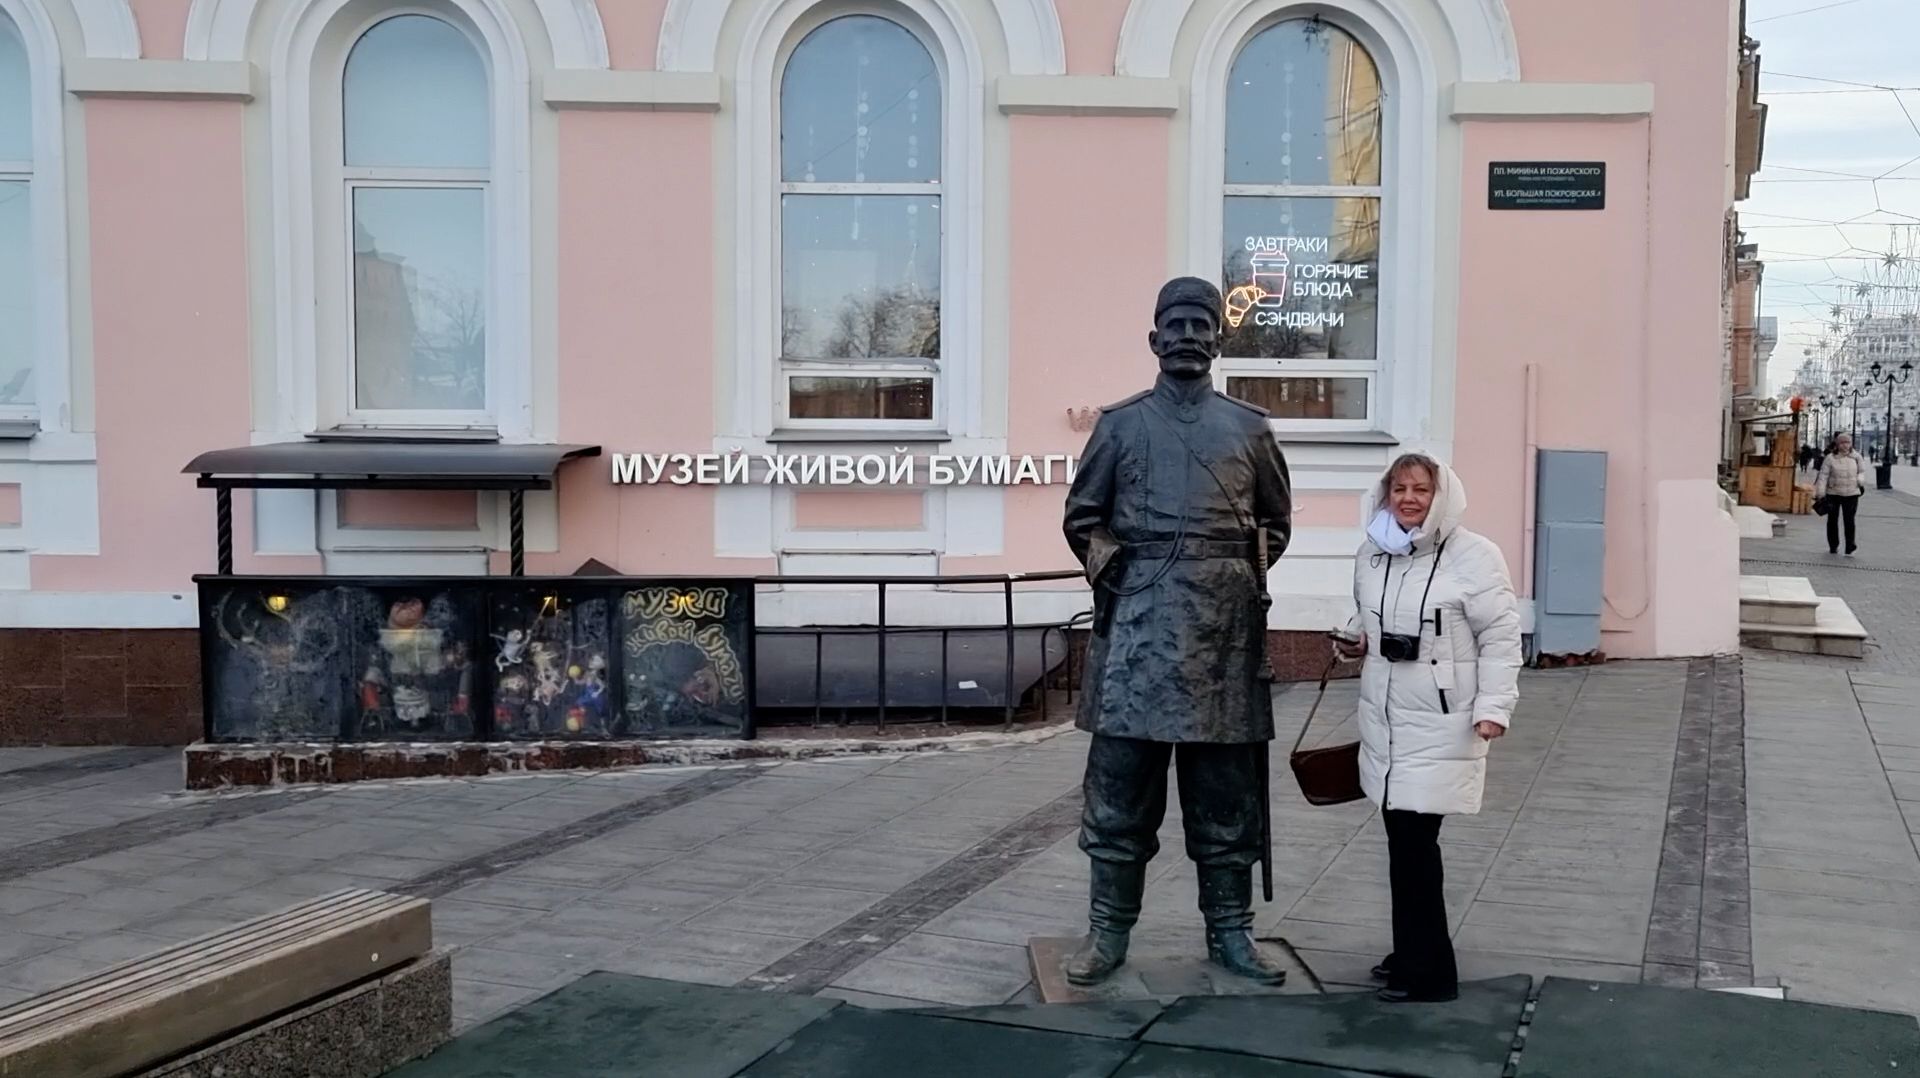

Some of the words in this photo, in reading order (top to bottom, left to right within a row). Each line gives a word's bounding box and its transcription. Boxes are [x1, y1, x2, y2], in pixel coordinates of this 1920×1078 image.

[1507, 167, 1539, 175] МИНИНА
[1540, 167, 1546, 175] И
[1547, 167, 1600, 175] ПОЖАРСКОГО
[1506, 190, 1544, 198] БОЛЬШАЯ
[1245, 236, 1328, 253] ЗАВТРАКИ
[1294, 265, 1368, 279] ГОРЯЧИЕ
[1293, 282, 1353, 300] БЛЮДА
[1255, 312, 1344, 328] СЭНДВИЧИ
[611, 446, 749, 485] МУЗЕЙ
[763, 446, 915, 485] ЖИВОЙ
